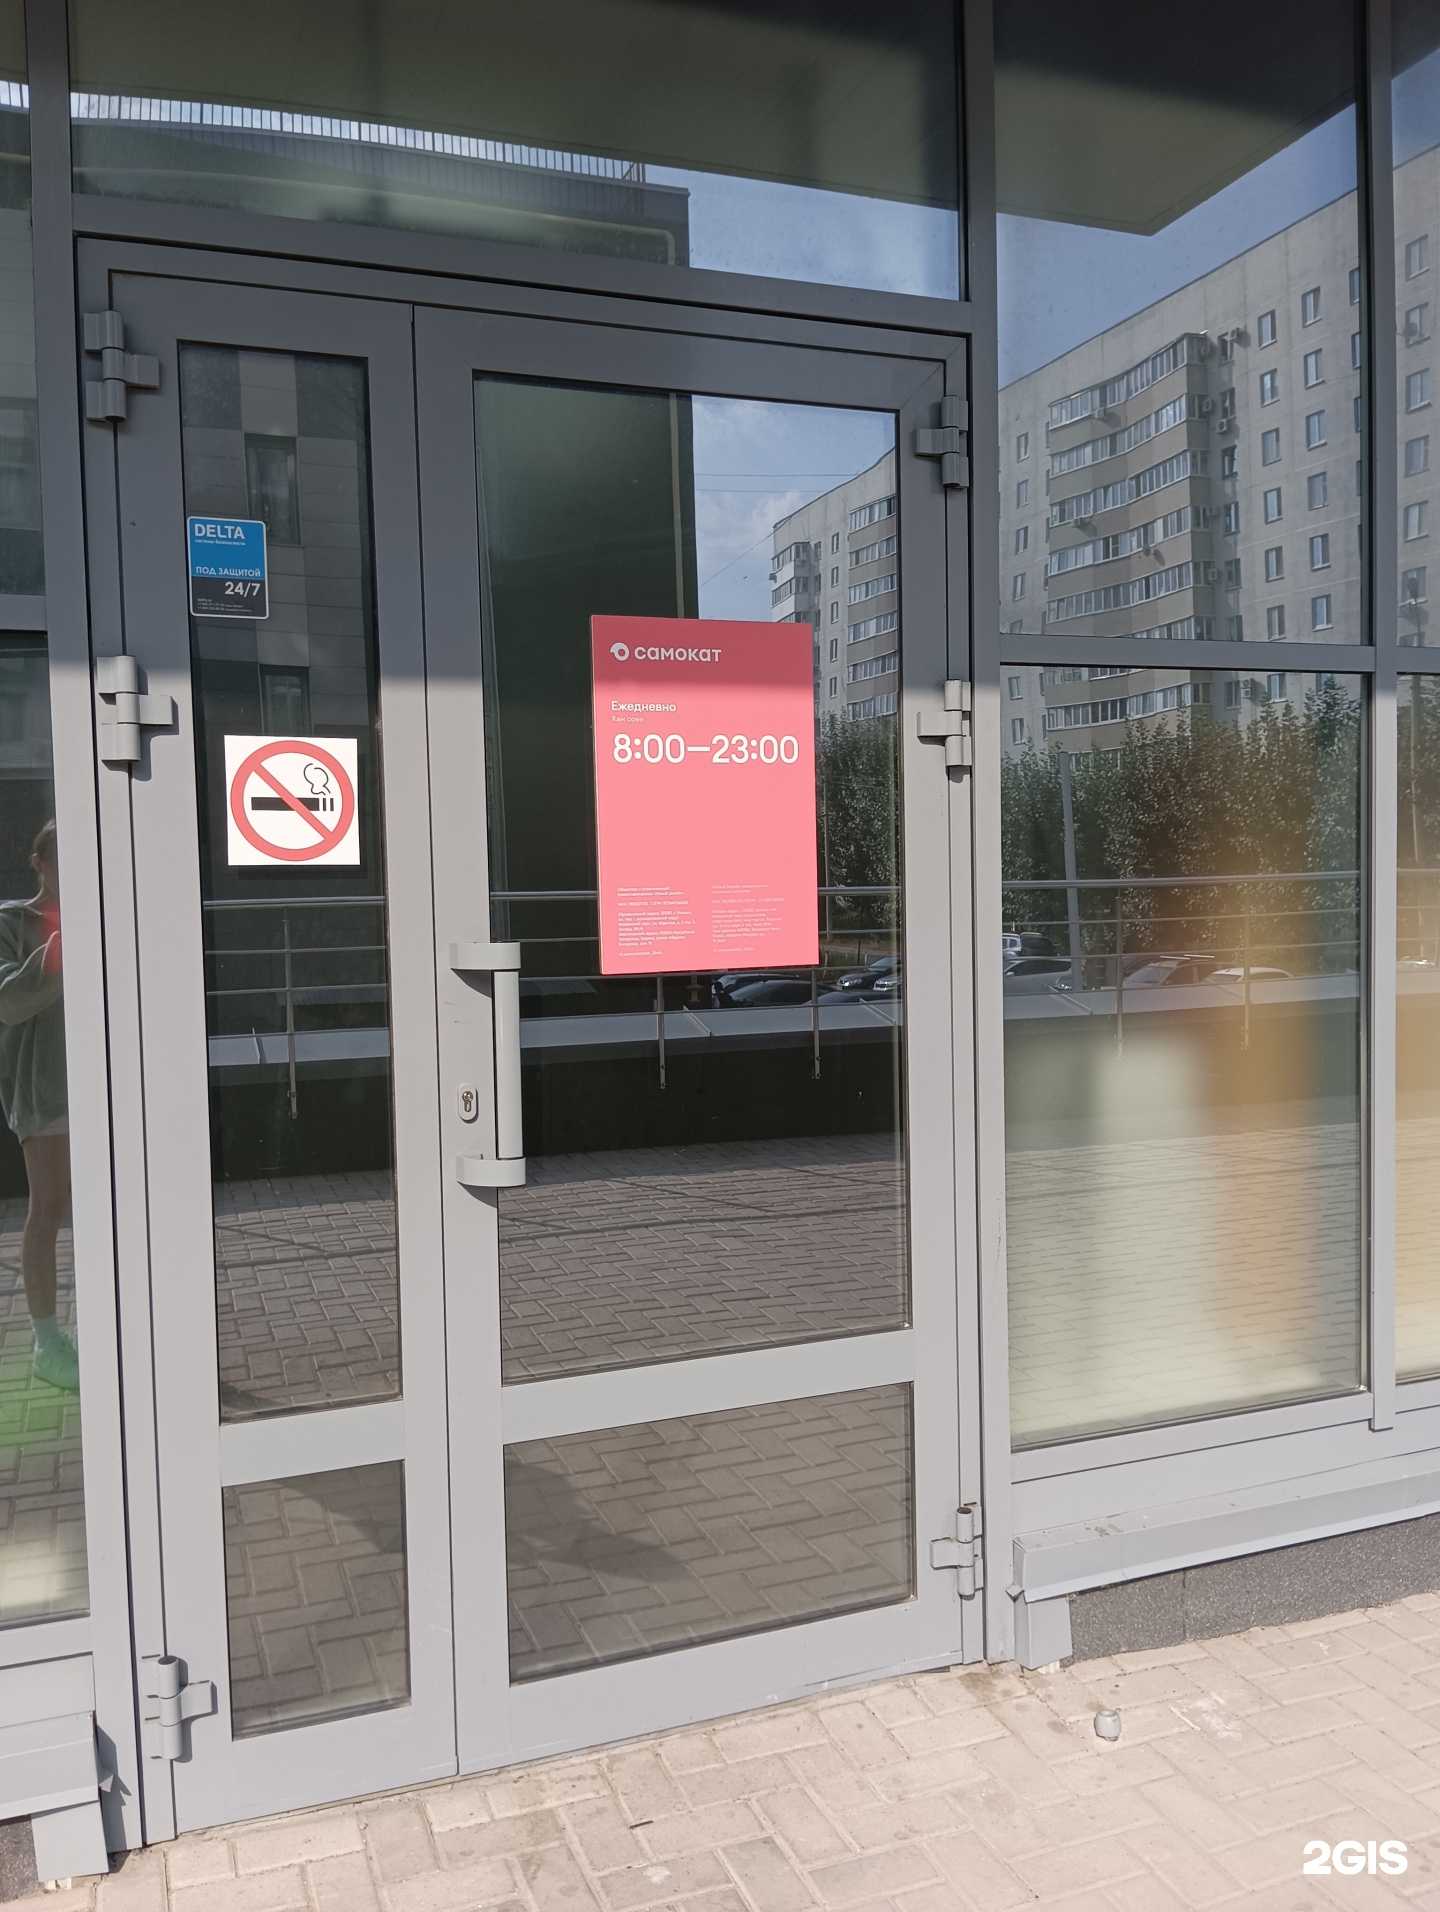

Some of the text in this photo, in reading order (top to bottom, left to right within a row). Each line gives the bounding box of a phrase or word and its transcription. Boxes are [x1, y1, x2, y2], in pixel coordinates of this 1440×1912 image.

[194, 523, 246, 540] DELTA
[196, 566, 261, 577] ПОД ЗАЩИТОЙ
[224, 581, 261, 598] 24/7
[634, 646, 722, 663] самокат
[611, 700, 677, 713] Ежедневно
